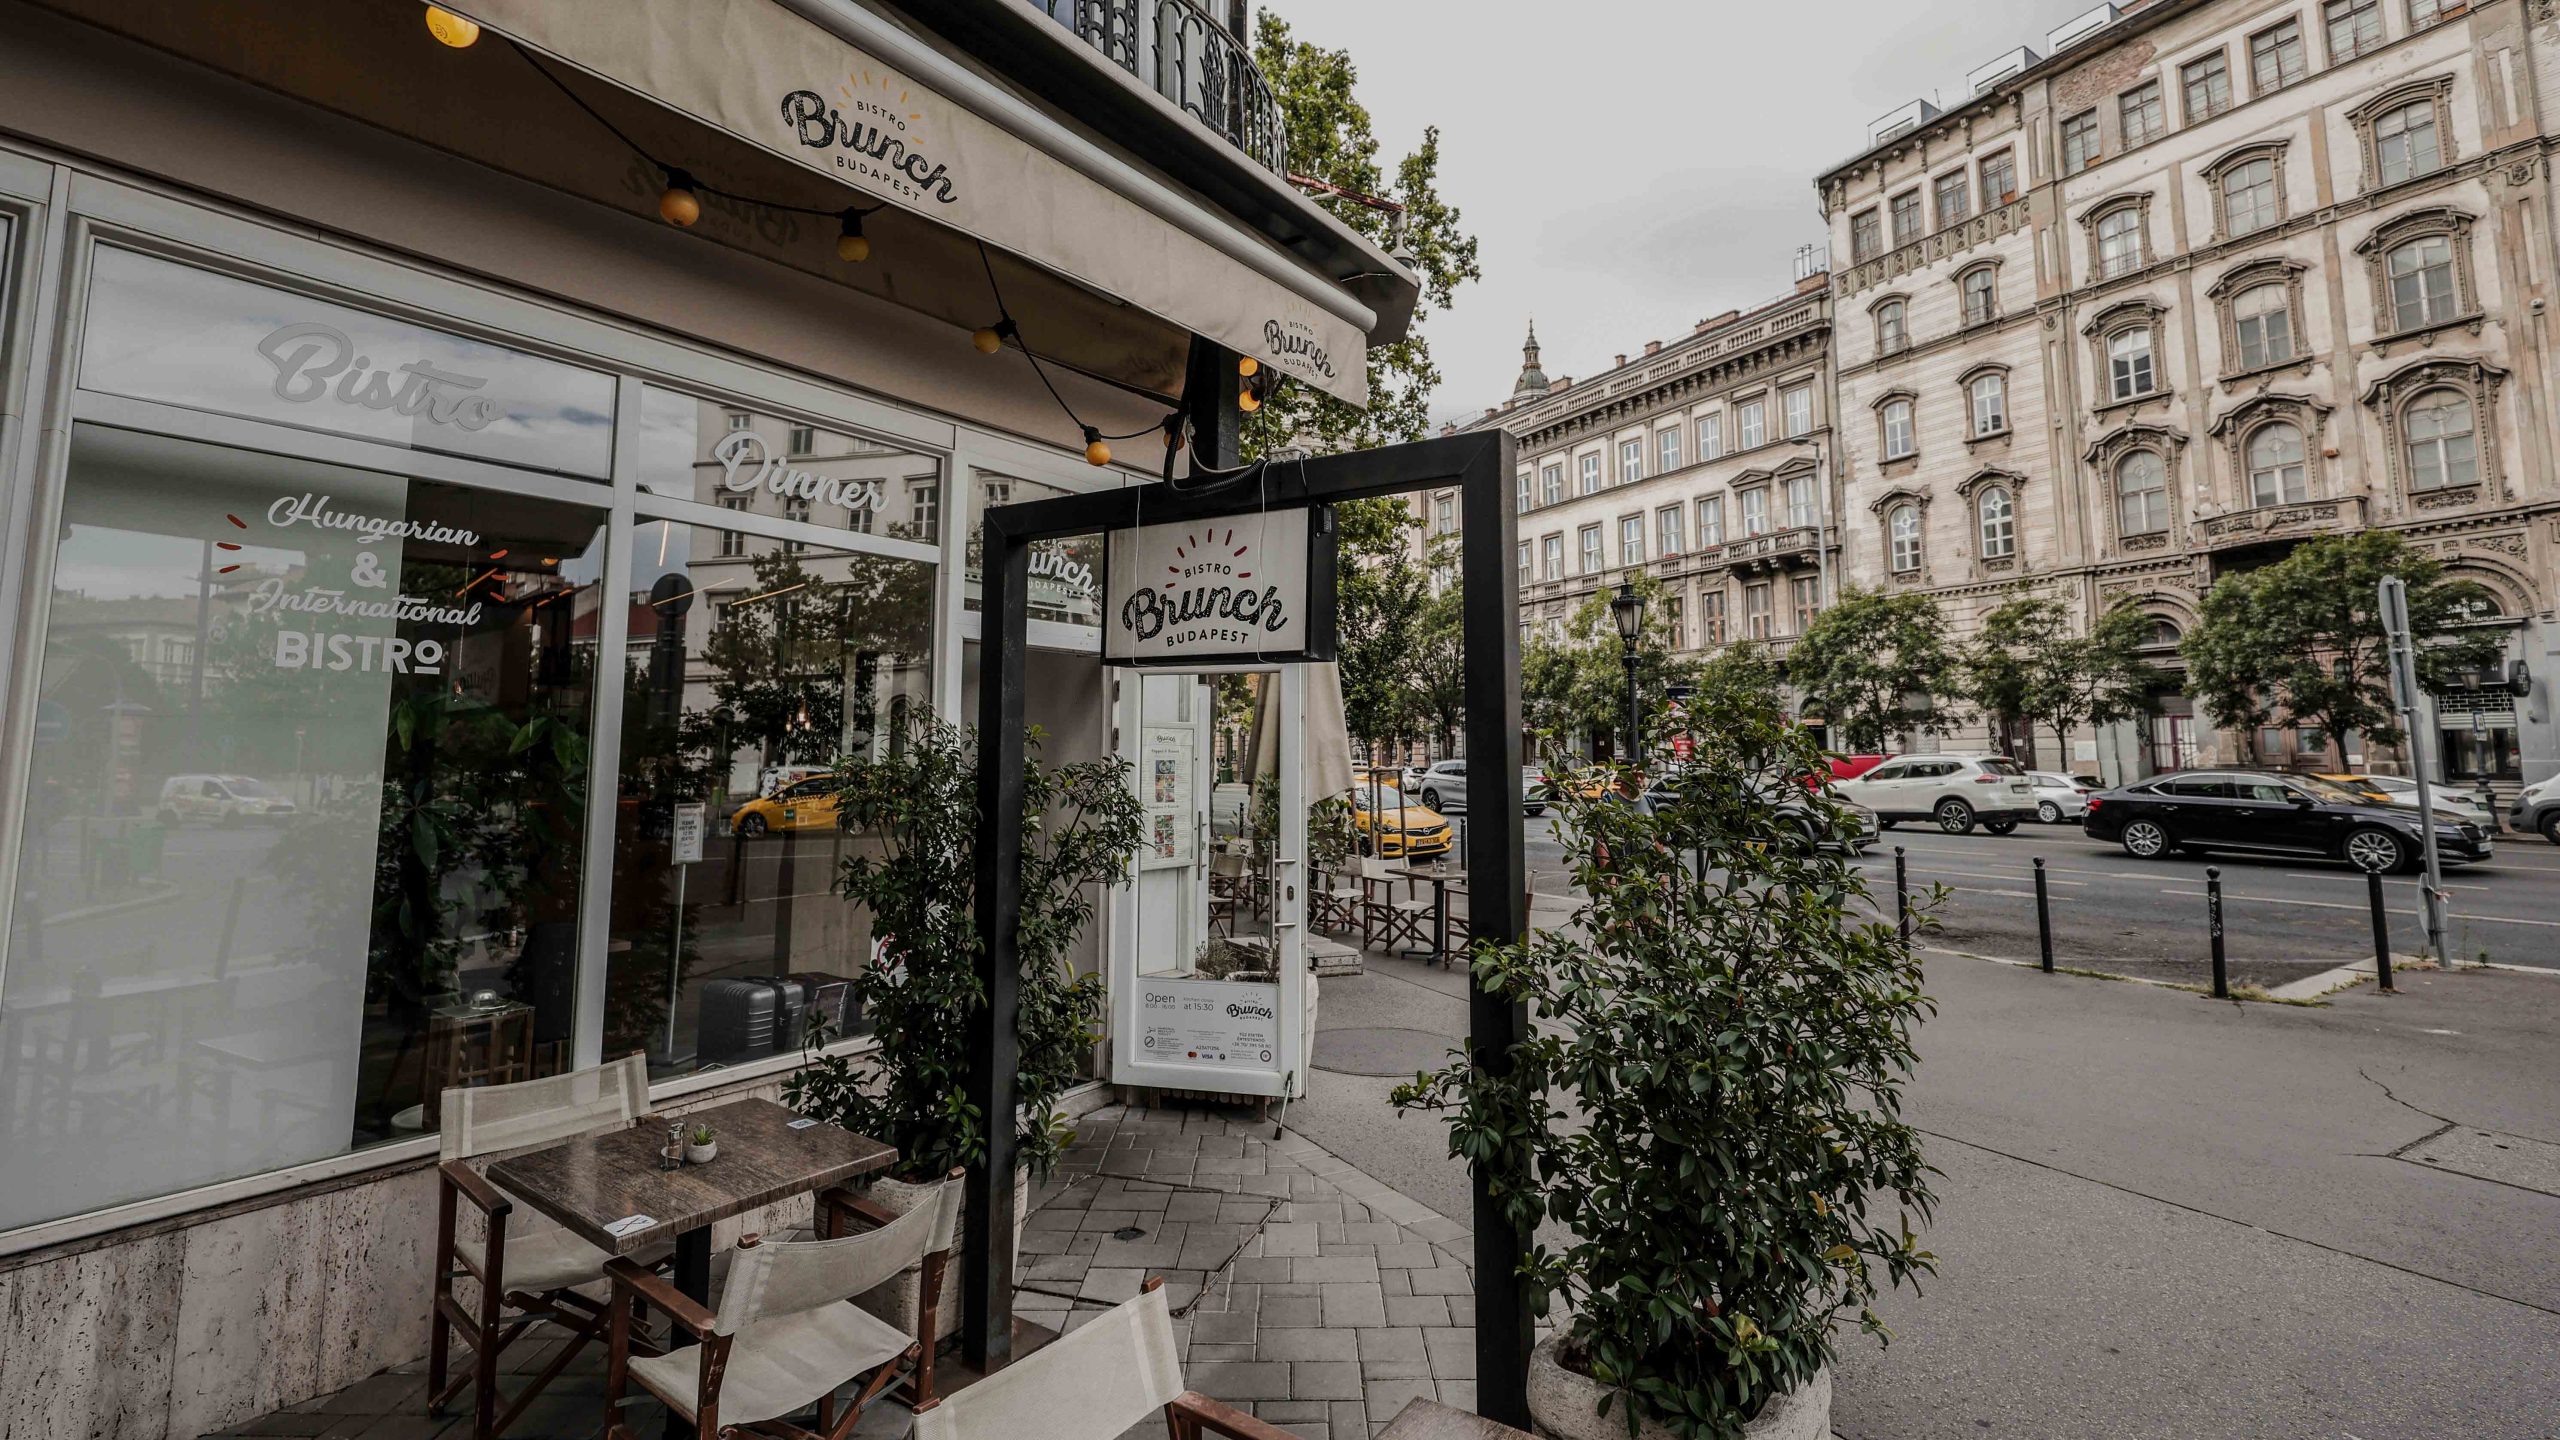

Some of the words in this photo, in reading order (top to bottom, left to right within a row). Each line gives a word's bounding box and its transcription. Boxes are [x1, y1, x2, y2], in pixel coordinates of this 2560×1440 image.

[856, 99, 907, 131] BISTRO
[780, 89, 958, 204] Brunch
[836, 154, 921, 202] BUDAPEST
[1263, 319, 1336, 378] Brunch
[1289, 321, 1314, 336] BISTRO
[256, 321, 509, 432] Bistro
[1283, 358, 1319, 380] BUDAPEST
[714, 430, 890, 513] Dinner
[267, 492, 480, 548] Hungarian
[350, 551, 388, 589] &
[1028, 551, 1096, 594] unch
[1184, 562, 1232, 578] BISTRO
[251, 577, 483, 627] International
[1121, 585, 1289, 642] Brunch
[1166, 628, 1249, 647] BUDAPEST
[1145, 992, 1175, 1005] Open
[1193, 1003, 1214, 1011] 15:30
[1226, 1003, 1274, 1020] Brunch
